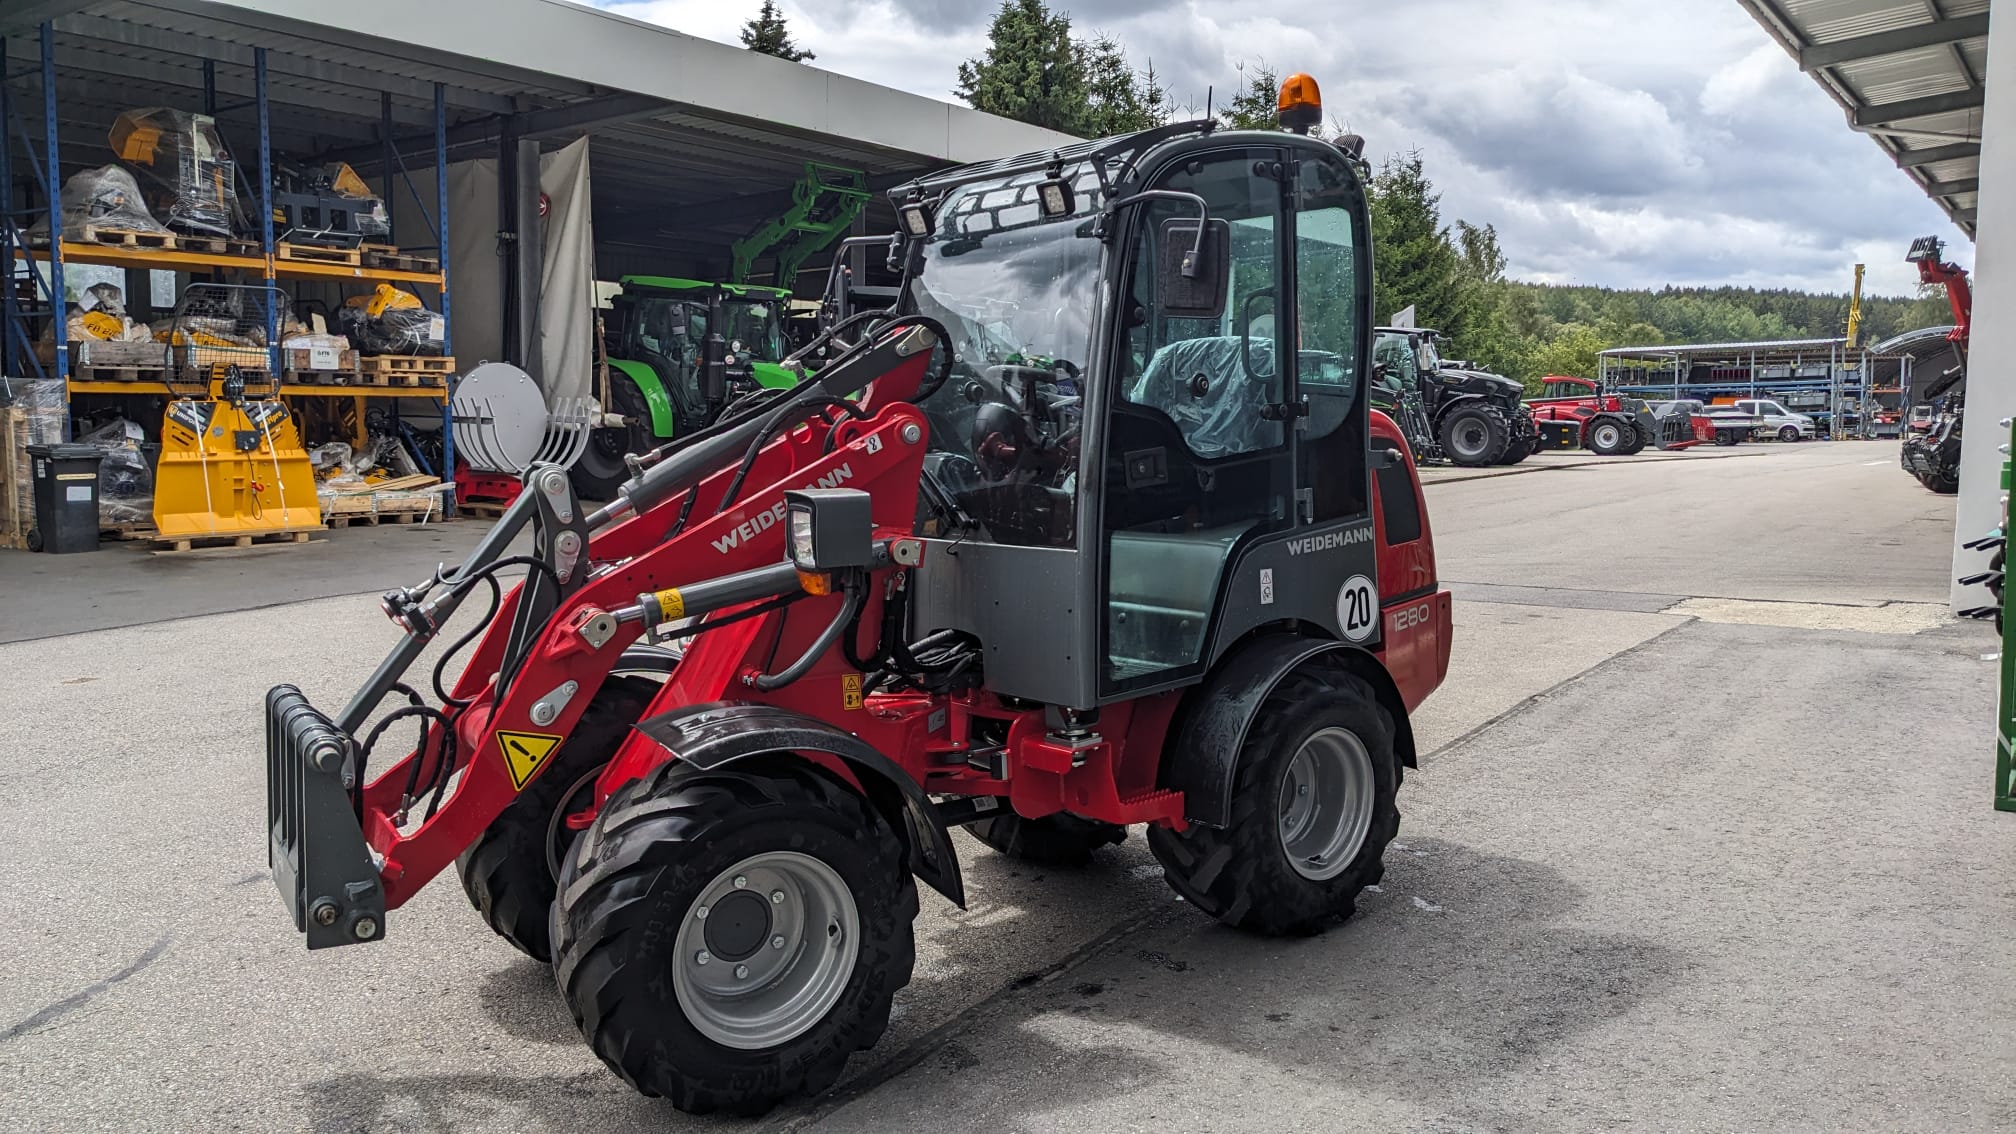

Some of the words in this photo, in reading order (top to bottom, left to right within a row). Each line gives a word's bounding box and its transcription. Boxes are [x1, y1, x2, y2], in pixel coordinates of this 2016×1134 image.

[711, 462, 854, 555] WEIDENN
[1287, 527, 1373, 556] WEIDEMANN
[1345, 586, 1371, 631] 20
[1392, 604, 1429, 632] 1280
